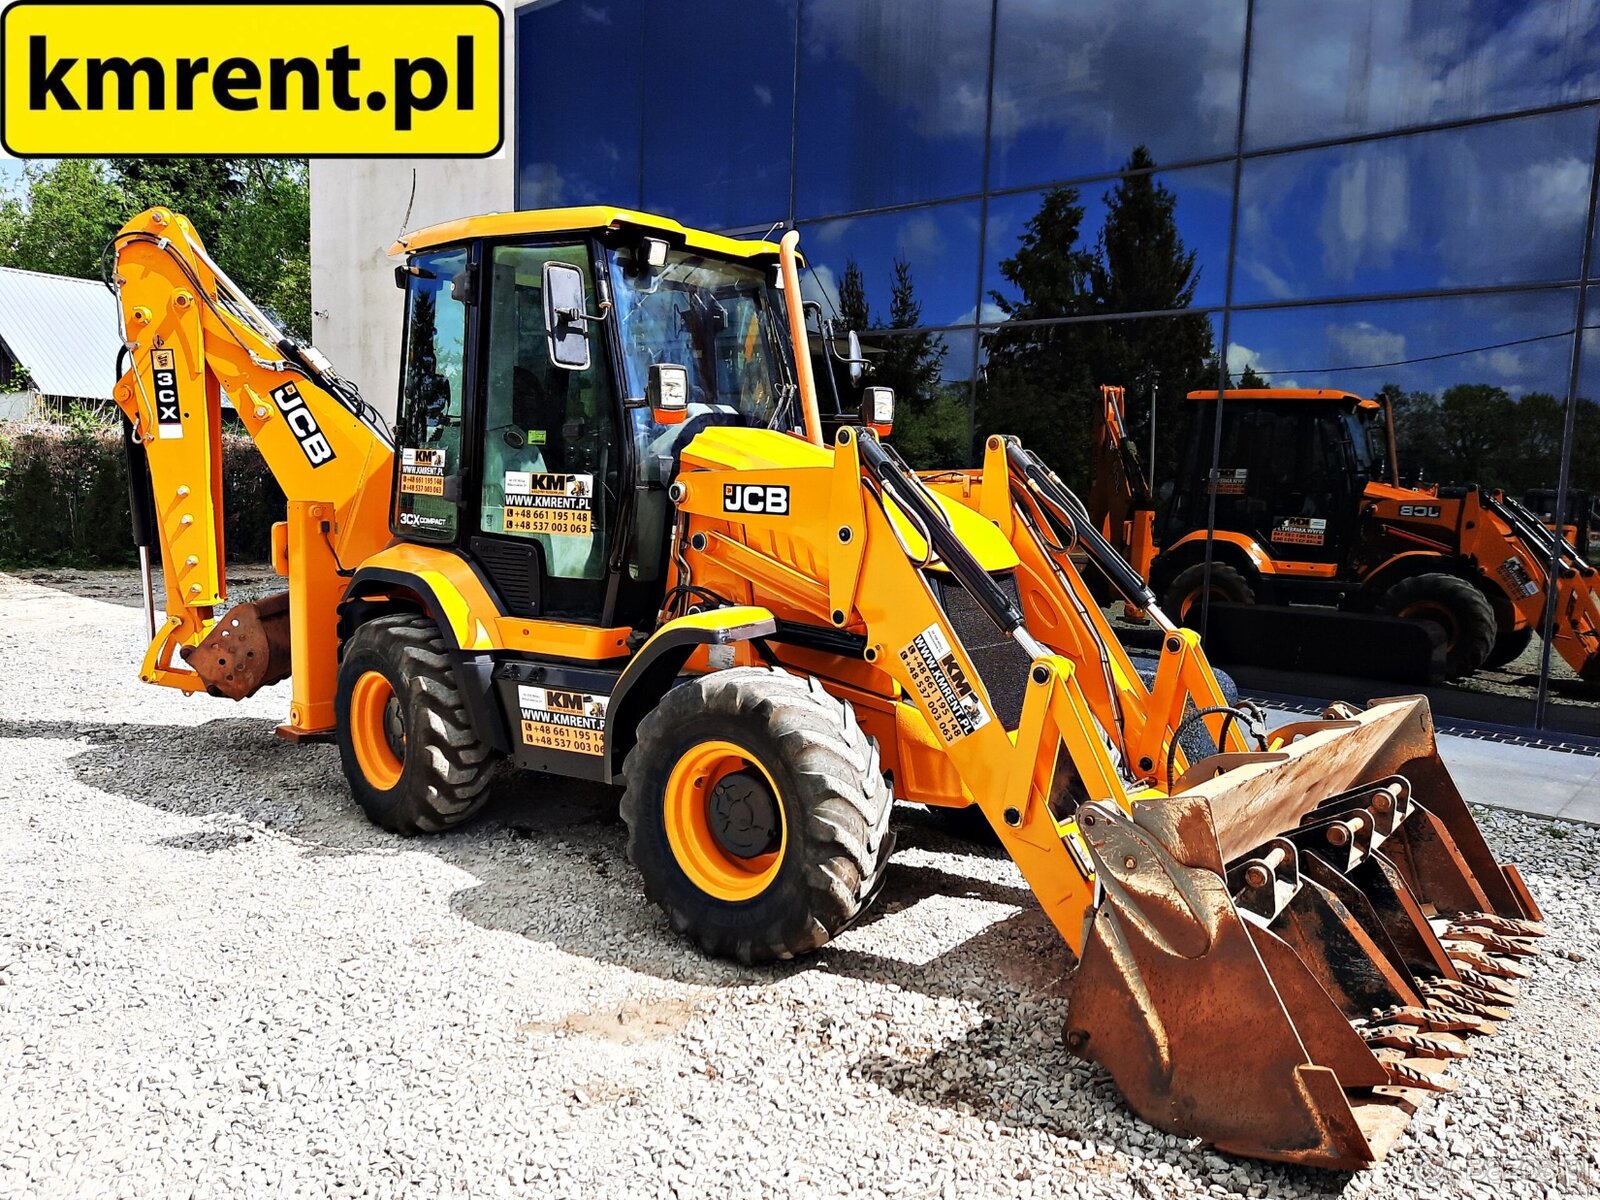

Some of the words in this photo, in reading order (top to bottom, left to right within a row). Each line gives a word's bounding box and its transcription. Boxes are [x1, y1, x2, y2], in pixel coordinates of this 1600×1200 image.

[157, 372, 178, 420] 3CX
[273, 389, 333, 465] JCB
[415, 450, 432, 462] KM
[532, 474, 565, 490] KM
[505, 495, 591, 510] WWW.KMRENT.PL
[725, 486, 787, 513] JCB
[515, 510, 531, 518] +48
[533, 510, 549, 519] 661
[553, 511, 568, 520] 195
[572, 512, 587, 522] 148
[515, 521, 531, 529] +48
[533, 522, 549, 531] 537
[551, 523, 568, 532] 003
[570, 524, 587, 533] 063
[915, 635, 972, 735] WWW.KMRENT.PL
[941, 653, 972, 697] KM
[546, 691, 583, 710] KM
[905, 661, 919, 680] +48
[917, 680, 931, 699] 537
[927, 701, 942, 720] 003
[939, 722, 953, 742] 063
[913, 655, 926, 674] +48
[924, 675, 938, 694] 661
[936, 696, 949, 716] 195
[947, 717, 962, 737] 148
[521, 708, 605, 730] WWW.KMRENT.P
[533, 725, 551, 734] +48
[553, 727, 570, 737] 661
[573, 730, 590, 740] 195
[594, 733, 604, 742] 14
[535, 736, 552, 746] +48
[555, 738, 571, 748] 537
[574, 740, 591, 751] 003
[594, 744, 604, 753] 06
